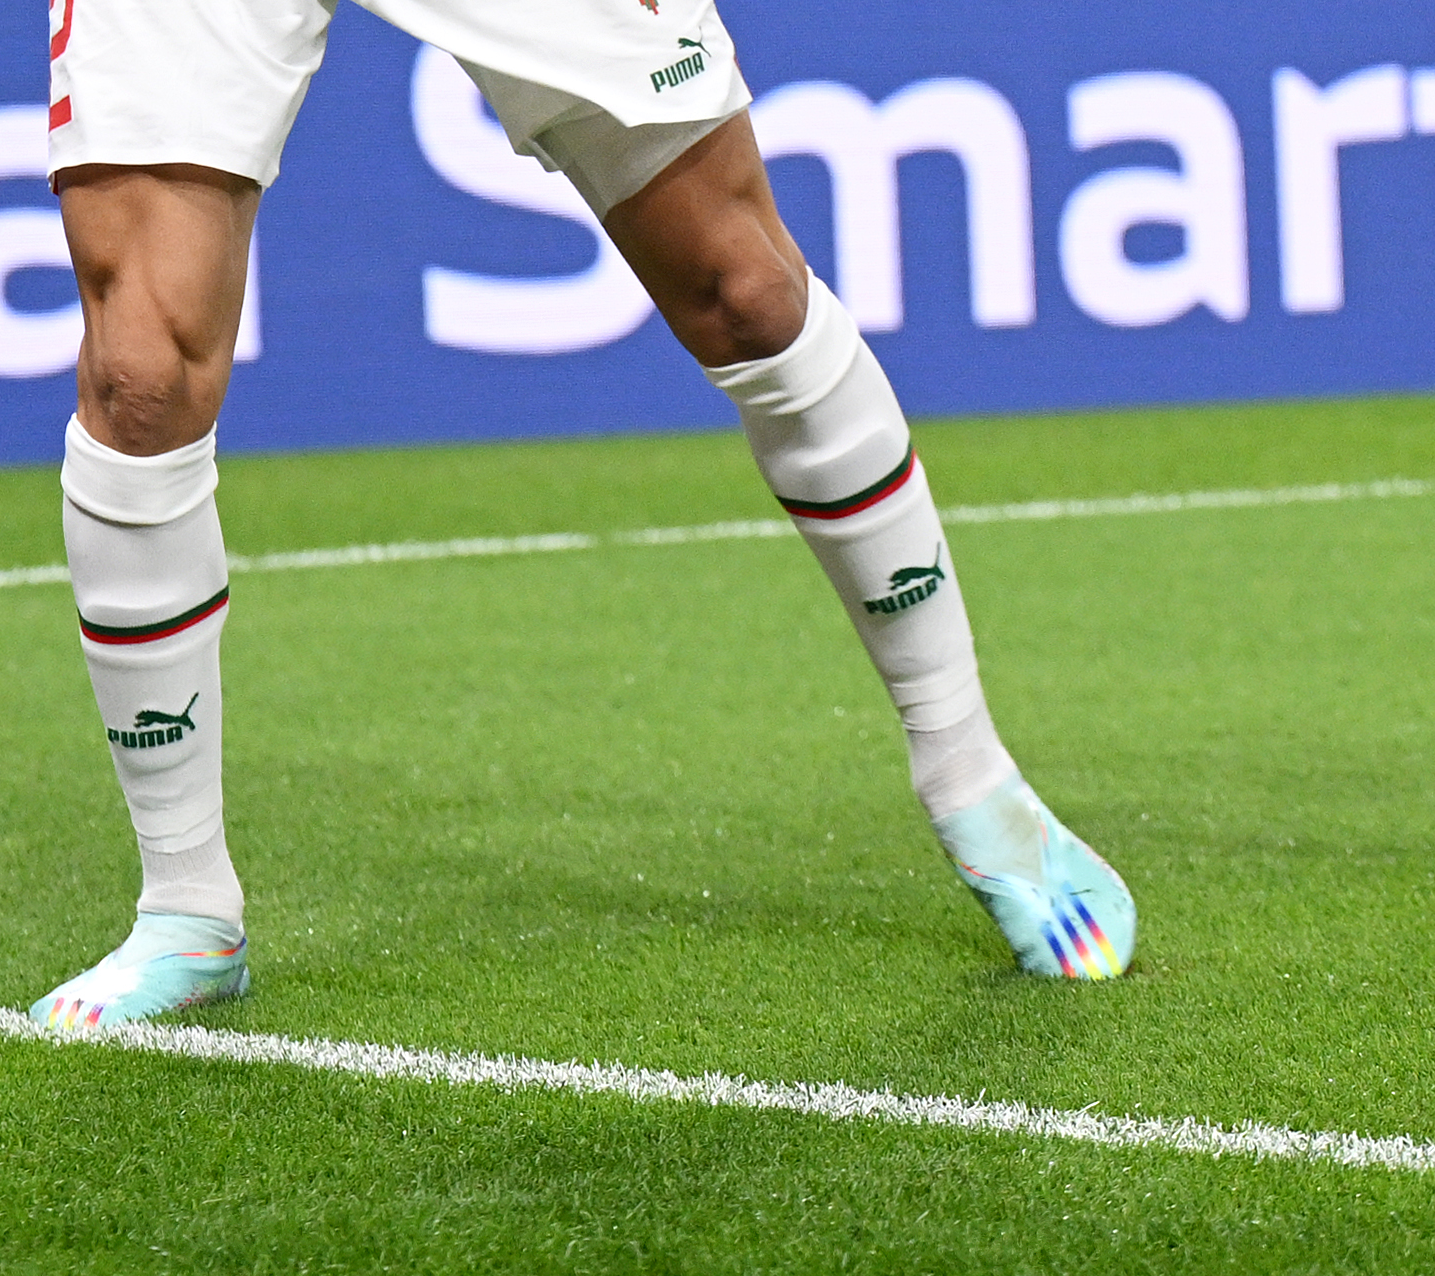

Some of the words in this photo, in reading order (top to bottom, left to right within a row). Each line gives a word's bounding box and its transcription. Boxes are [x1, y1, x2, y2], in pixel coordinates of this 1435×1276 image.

[649, 52, 705, 94] PUMA
[863, 577, 937, 614] PUMA
[107, 725, 183, 748] PUMA
